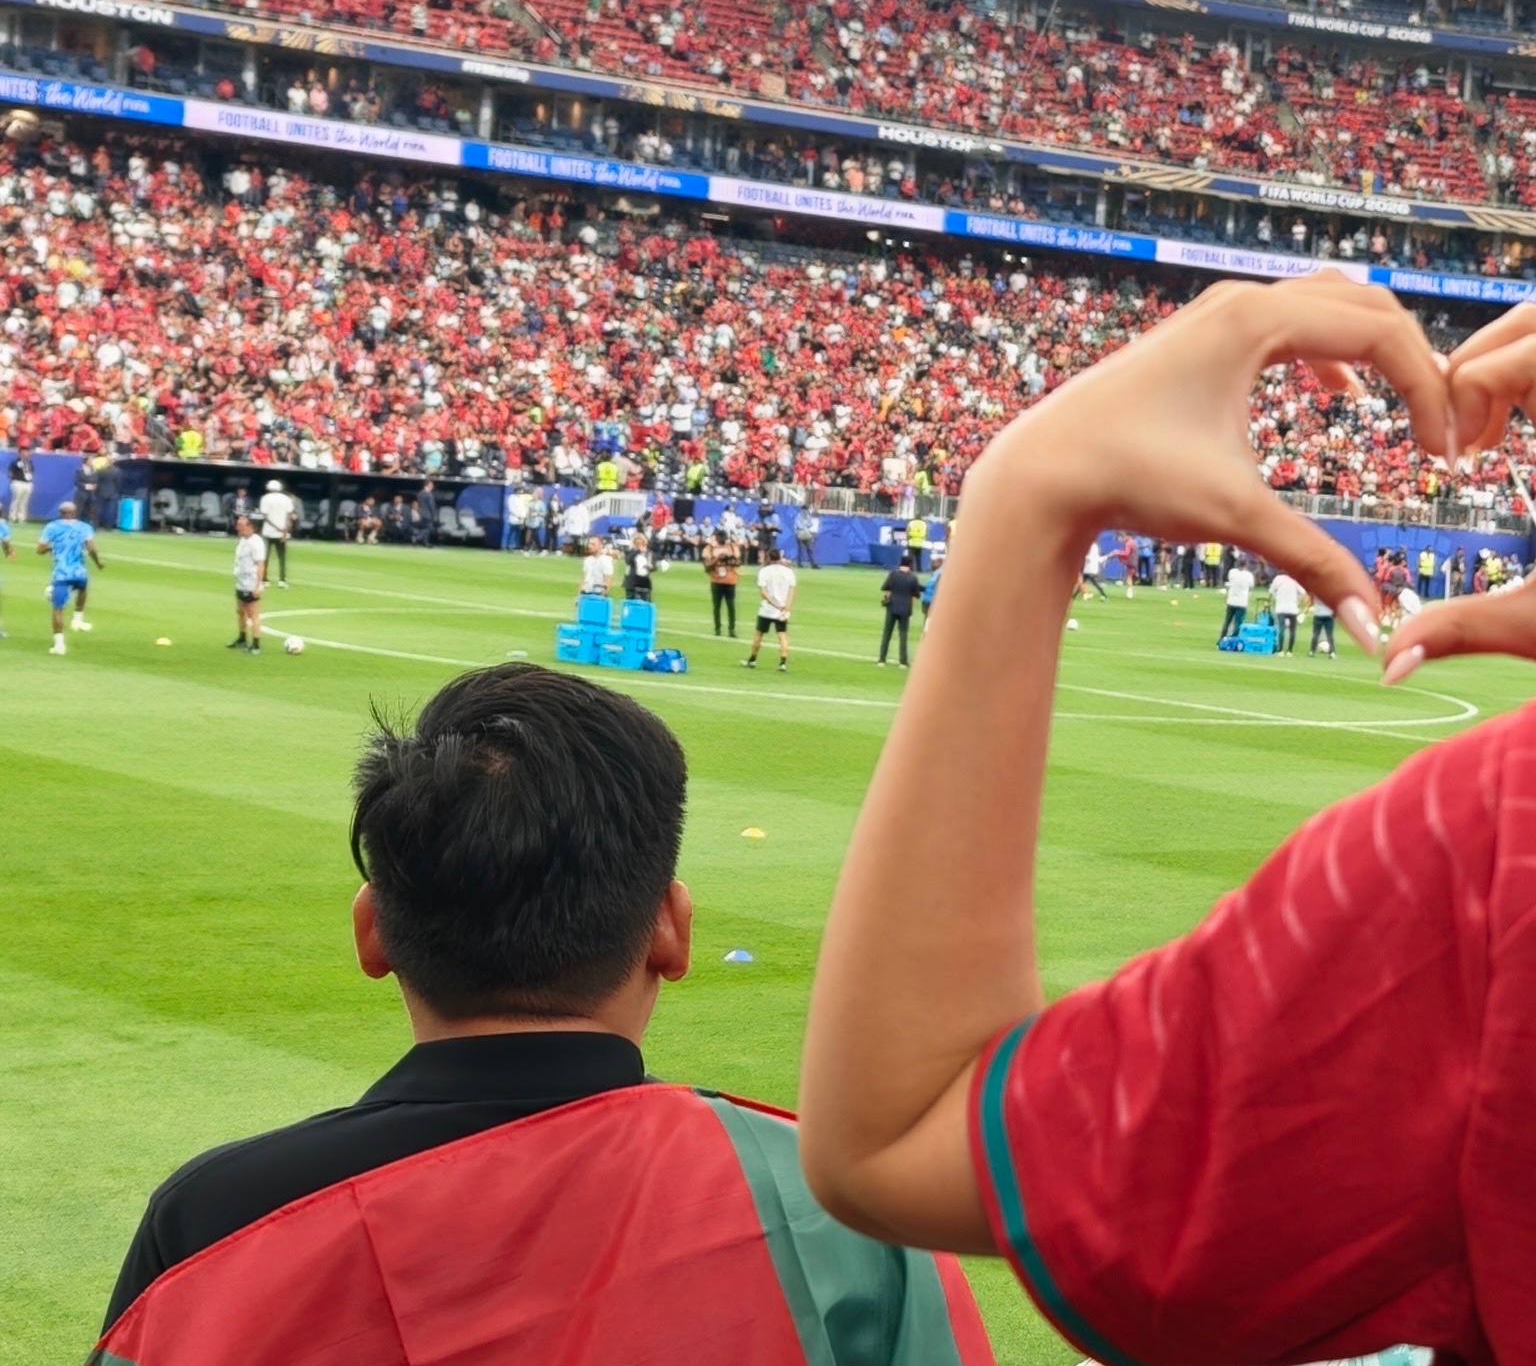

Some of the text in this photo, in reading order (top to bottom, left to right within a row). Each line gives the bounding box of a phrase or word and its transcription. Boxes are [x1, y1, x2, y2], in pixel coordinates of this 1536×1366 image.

[1288, 11, 1315, 28] FIFA
[1315, 16, 1360, 35] WORLD
[1359, 22, 1386, 38] CUP
[44, 82, 72, 104] the
[72, 86, 123, 115] World
[218, 110, 280, 135] FOOTBALL
[285, 121, 330, 141] UNITES
[334, 128, 356, 145] the
[358, 131, 401, 153] World
[488, 147, 549, 175] FOOTBALL
[551, 156, 593, 182] UNITES
[594, 161, 618, 183] the
[617, 164, 659, 191] World
[738, 187, 791, 207] FOOTBALL
[795, 195, 833, 212] UNITES
[837, 199, 855, 214] the
[857, 202, 893, 220] World
[1259, 186, 1411, 215] FIFA WORLD CUP 2026
[966, 216, 1017, 240] FOOTBALL
[1019, 223, 1056, 245] UNITES
[1057, 227, 1077, 247] the
[1076, 229, 1113, 252] World
[1181, 247, 1227, 266] FOOTBALL
[1230, 255, 1263, 270] UNITES
[1266, 259, 1285, 272] the
[1390, 271, 1441, 294] FOOTBALL
[1442, 277, 1481, 298] UNITES
